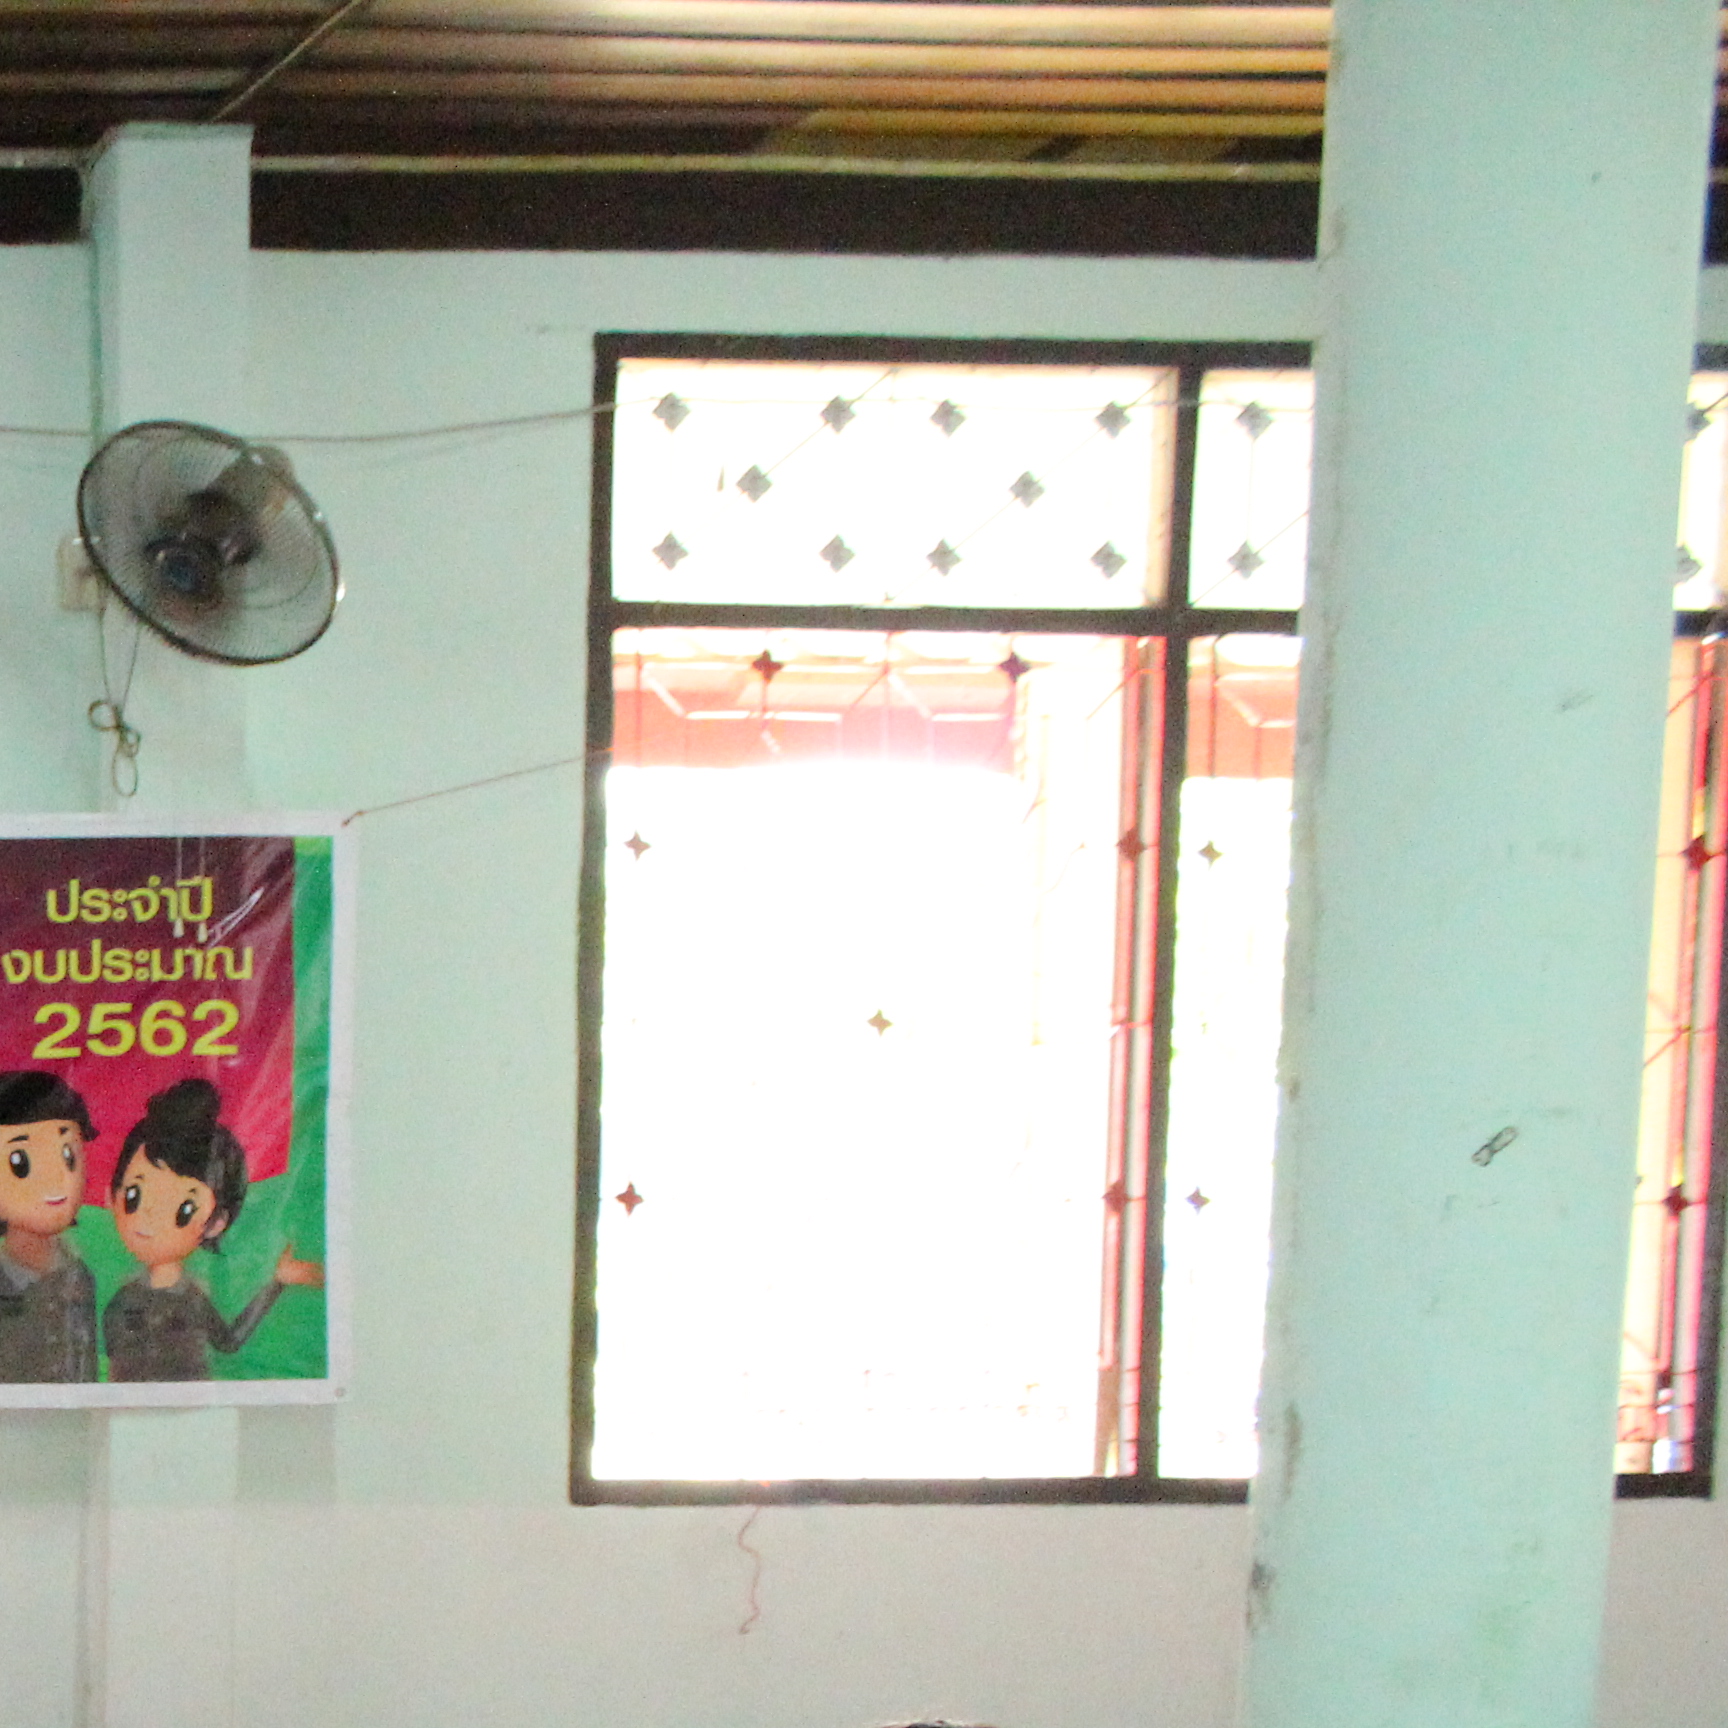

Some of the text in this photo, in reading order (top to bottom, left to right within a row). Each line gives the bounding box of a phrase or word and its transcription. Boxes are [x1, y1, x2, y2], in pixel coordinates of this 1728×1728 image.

[45, 874, 214, 923] ประจำปี
[0, 938, 254, 985] งบประมาณ
[31, 999, 240, 1060] 2562
